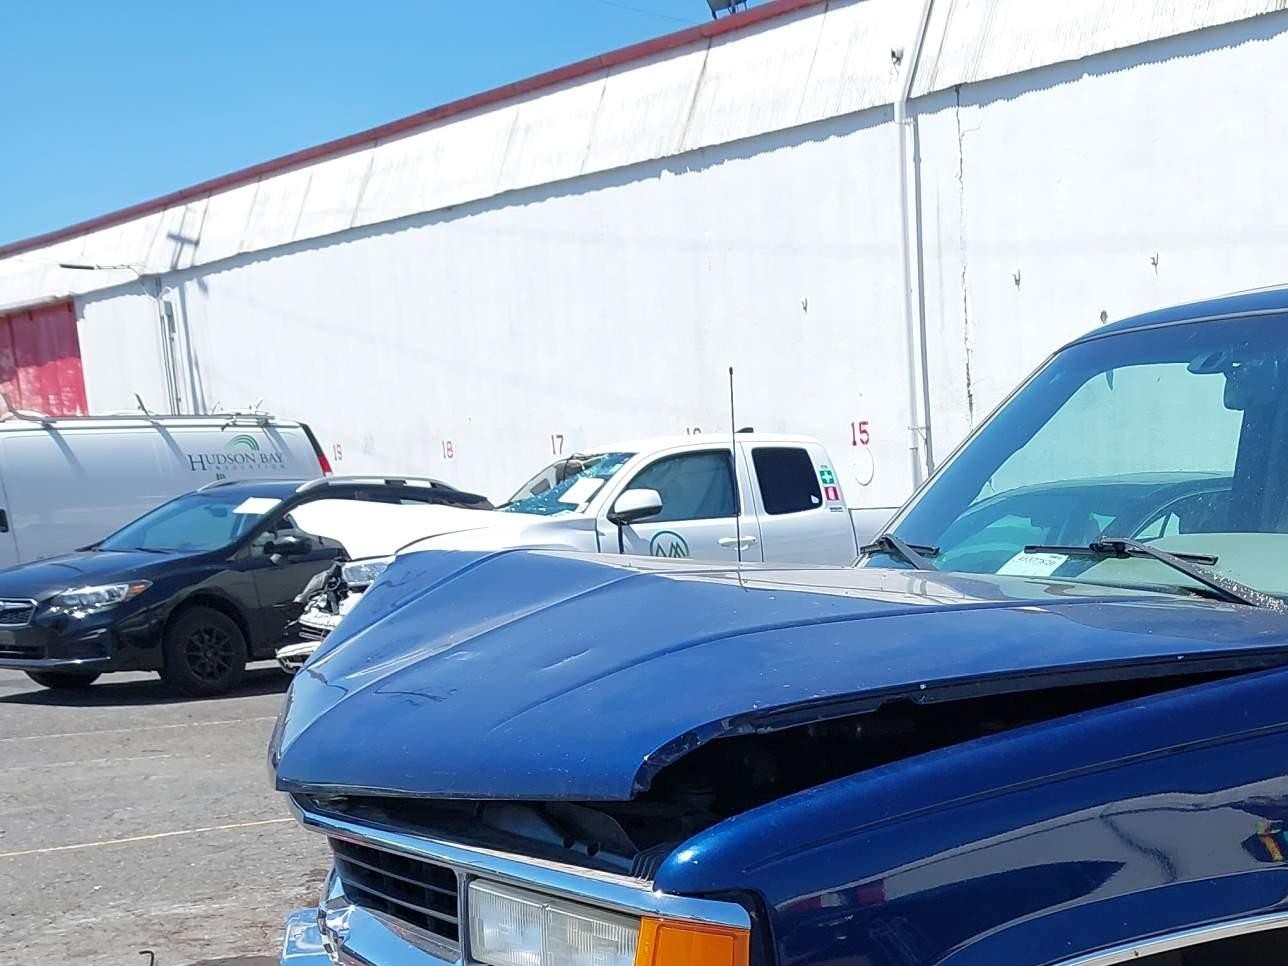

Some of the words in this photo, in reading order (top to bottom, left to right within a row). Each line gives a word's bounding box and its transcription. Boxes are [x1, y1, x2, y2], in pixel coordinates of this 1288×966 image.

[851, 421, 870, 446] 15
[441, 440, 454, 459] 18
[551, 434, 564, 455] 17
[187, 453, 257, 471] HUDSON
[260, 452, 283, 464] BAY
